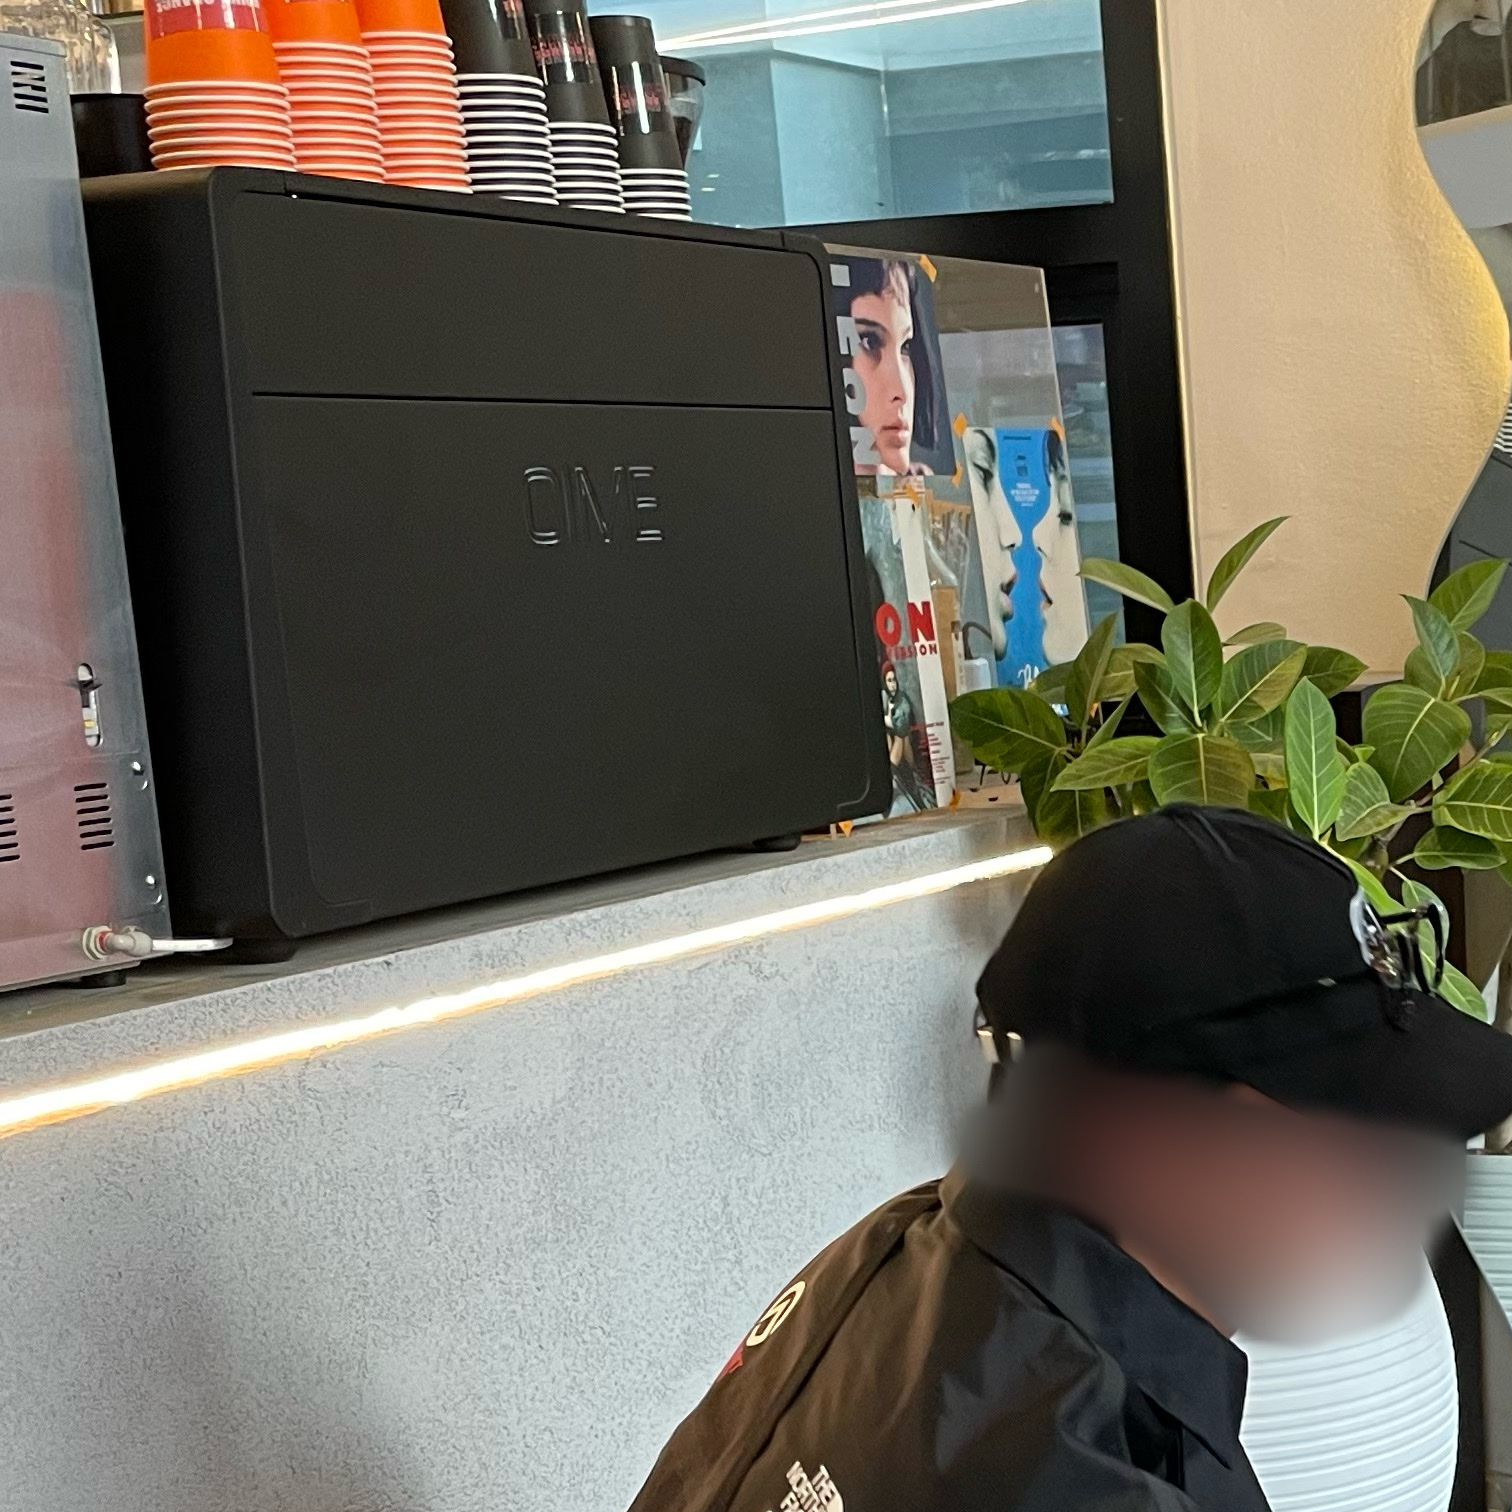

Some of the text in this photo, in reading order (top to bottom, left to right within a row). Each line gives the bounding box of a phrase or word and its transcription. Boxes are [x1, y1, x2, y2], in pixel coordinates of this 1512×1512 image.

[523, 464, 664, 546] ONE
[875, 601, 936, 647] ON
[811, 1464, 836, 1506] THE
